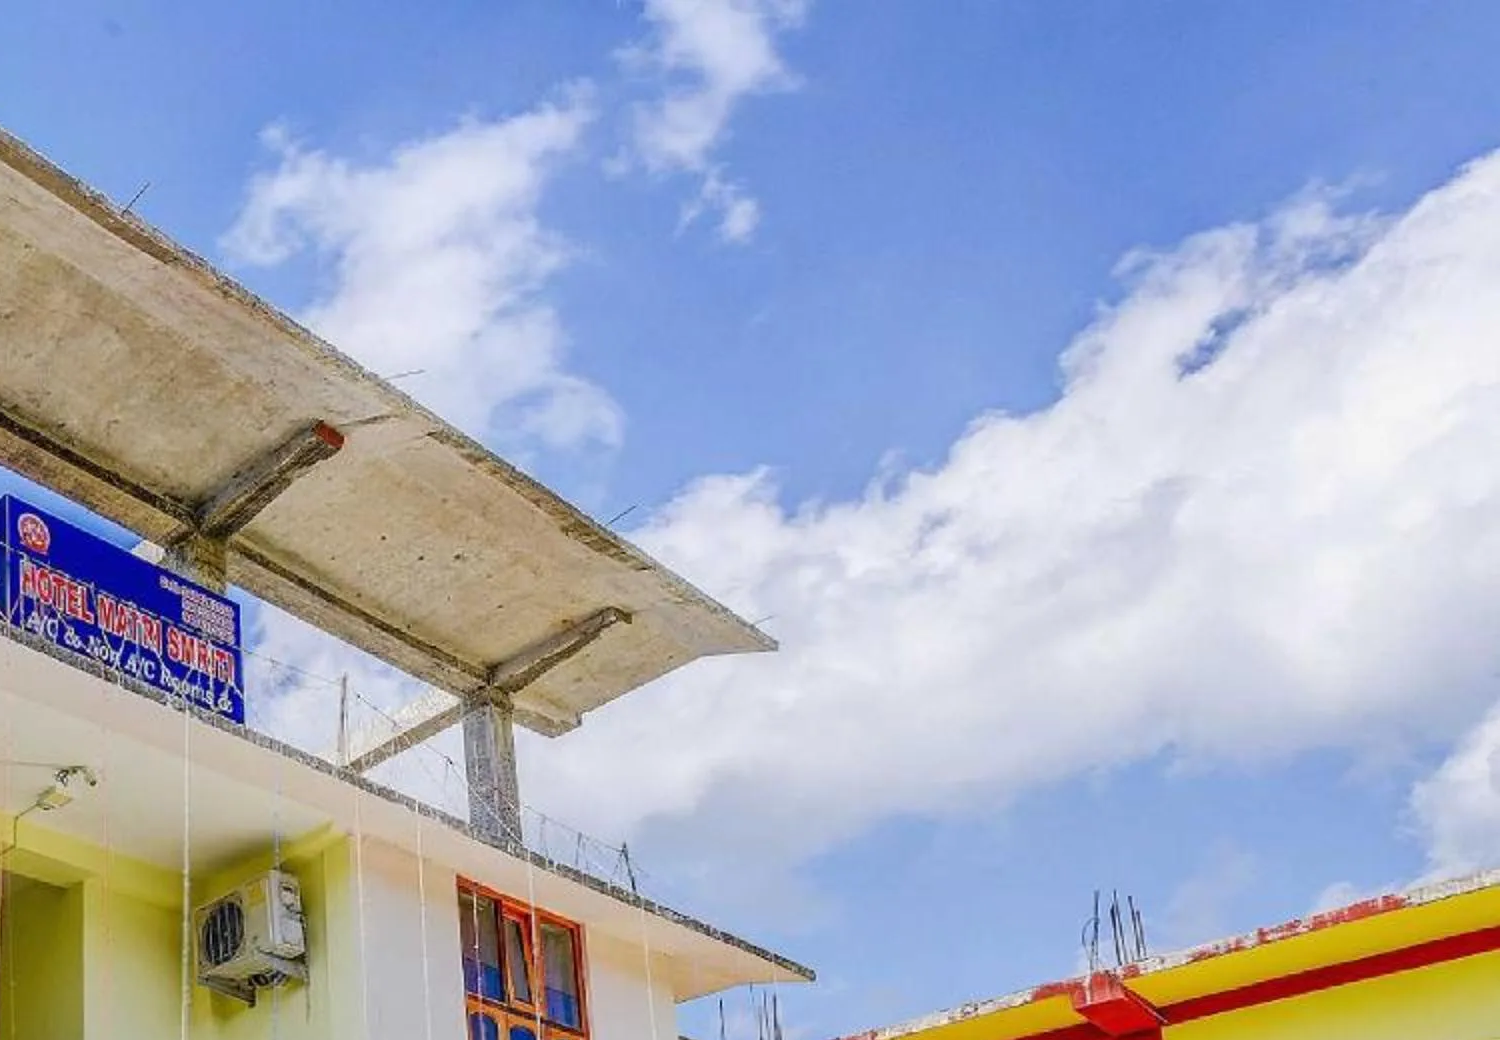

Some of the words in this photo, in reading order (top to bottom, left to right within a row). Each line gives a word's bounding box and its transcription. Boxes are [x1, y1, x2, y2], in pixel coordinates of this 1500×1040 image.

[20, 563, 94, 624] HOTEL
[63, 627, 81, 649] &
[124, 653, 156, 681] A/C
[217, 689, 233, 713] &
